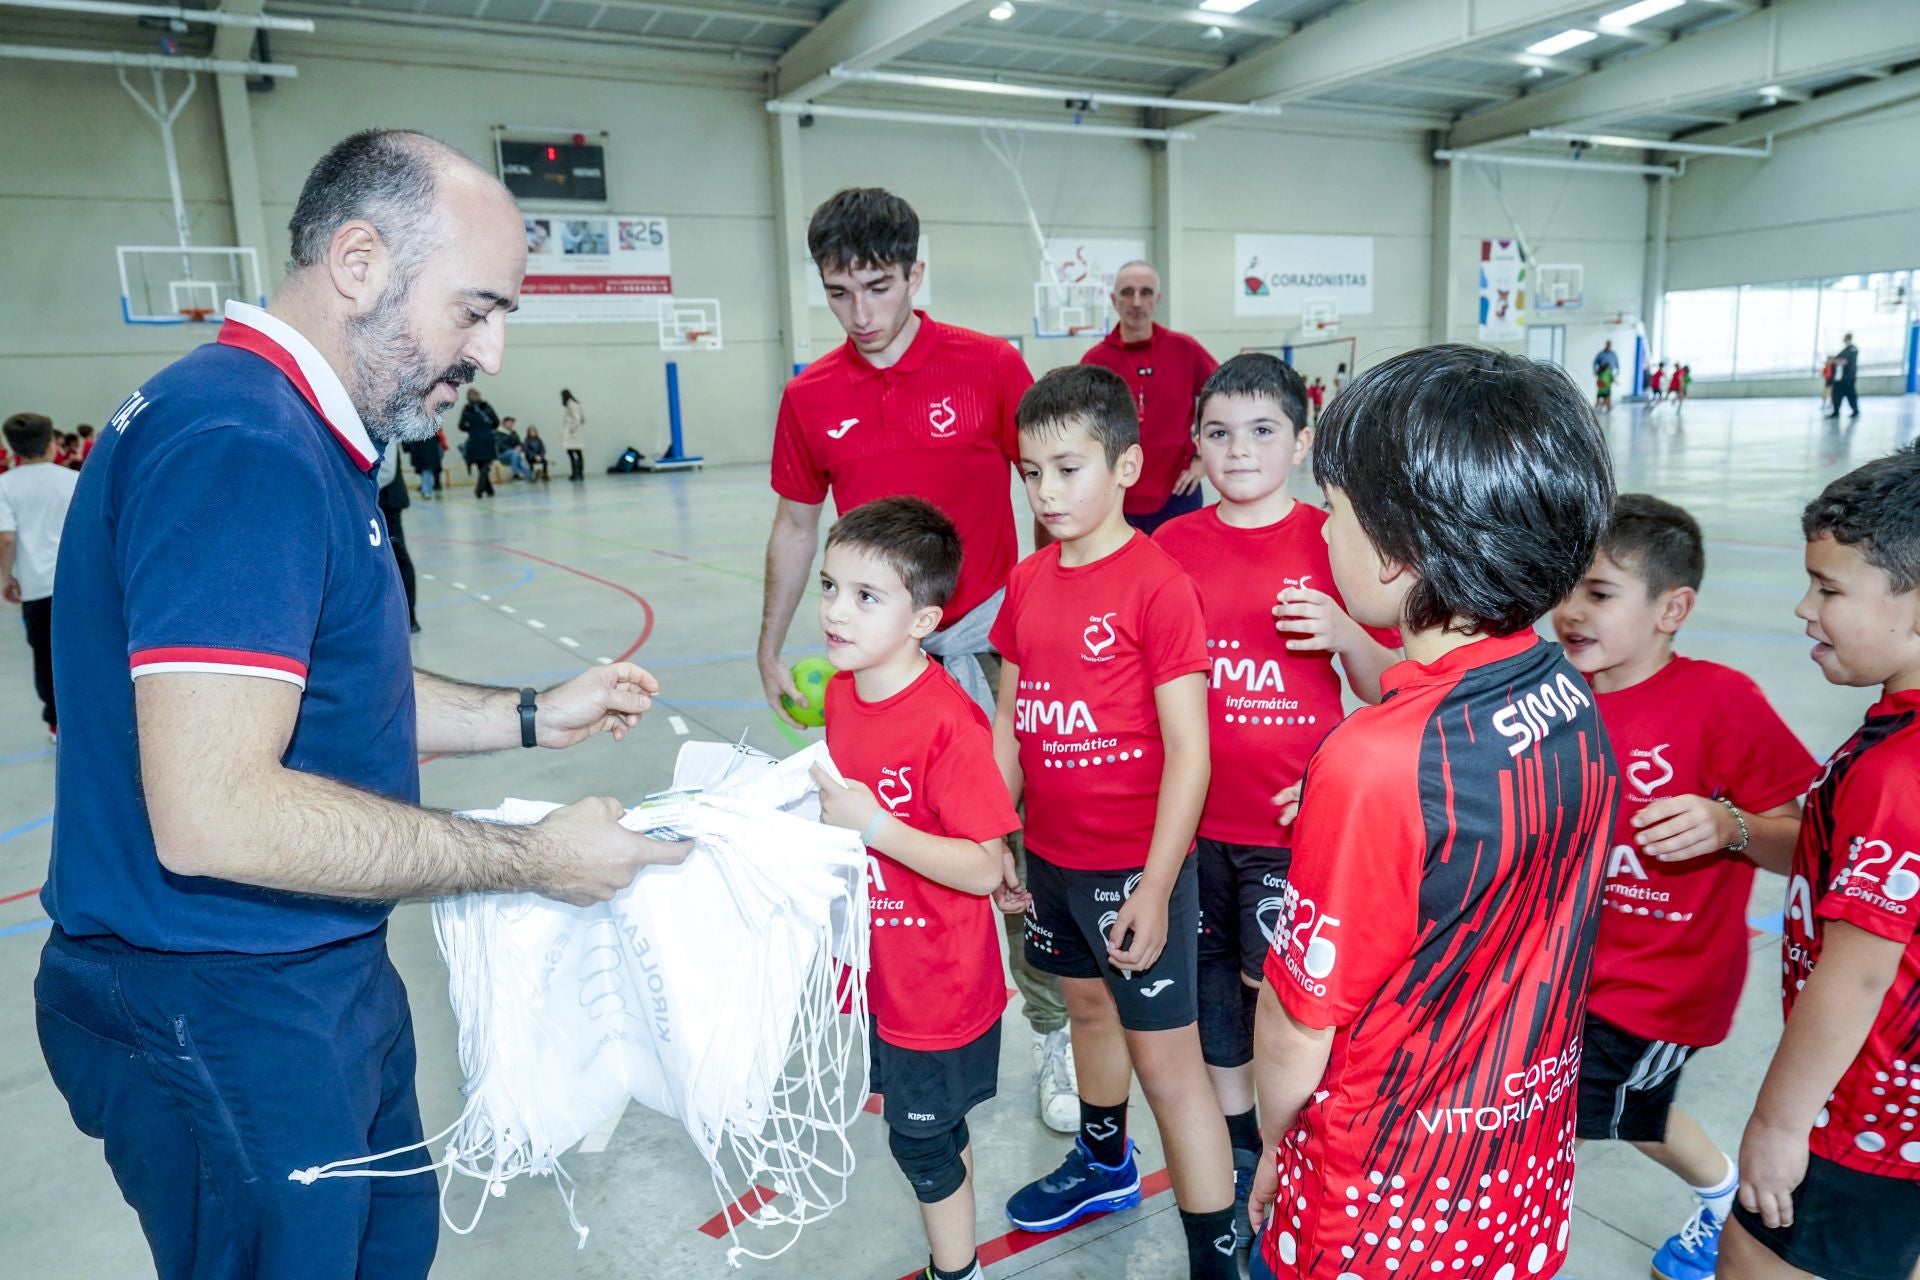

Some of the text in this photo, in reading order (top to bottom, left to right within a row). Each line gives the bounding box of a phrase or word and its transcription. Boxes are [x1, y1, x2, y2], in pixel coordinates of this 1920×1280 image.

[1270, 274, 1367, 287] CORAZONISTAS
[1225, 695, 1299, 710] informática
[1016, 698, 1099, 735] SIMA
[1491, 672, 1591, 758] SIMA
[1042, 737, 1118, 755] informática
[1262, 873, 1286, 889] Cora
[1094, 887, 1121, 902] Coras
[1844, 886, 1908, 915] CONTIGO
[1285, 953, 1327, 998] CONTIGO
[1504, 1036, 1579, 1098] CORAS
[907, 1112, 936, 1121] KIPSTA
